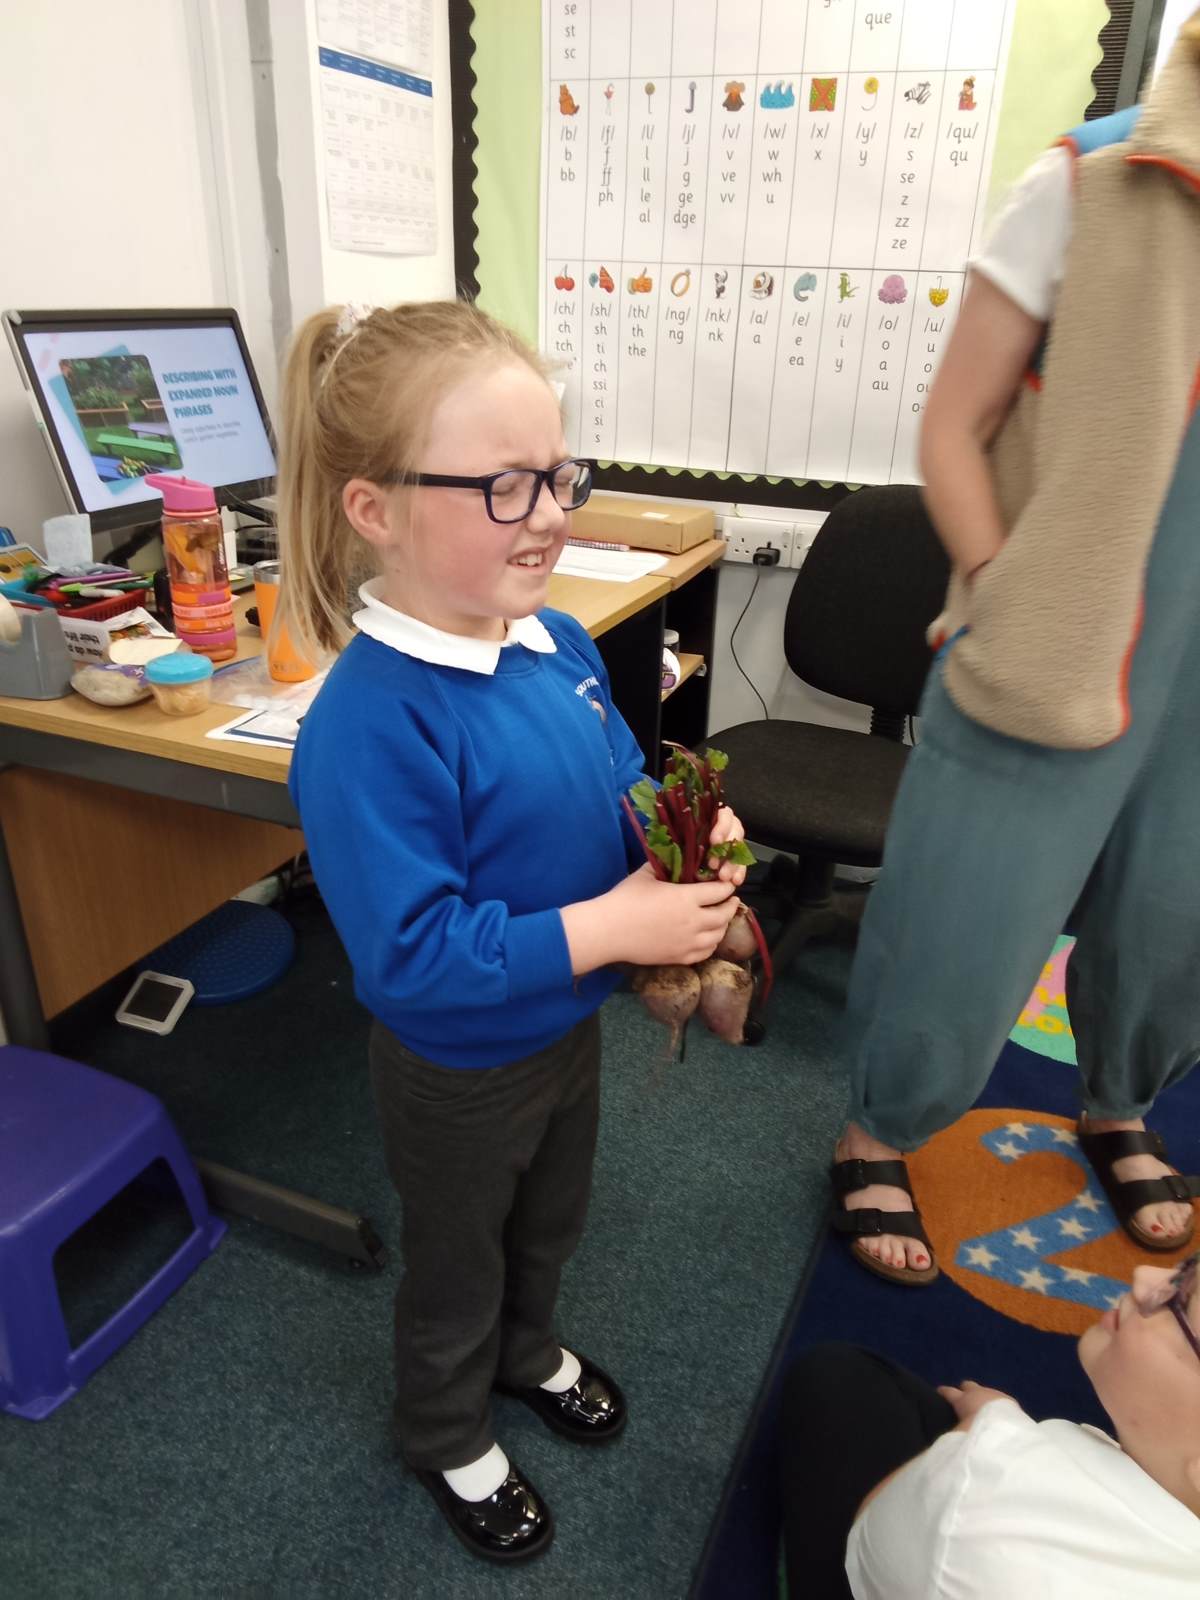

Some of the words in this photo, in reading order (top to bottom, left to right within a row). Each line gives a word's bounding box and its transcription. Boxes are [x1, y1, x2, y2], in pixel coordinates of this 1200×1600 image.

[563, 3, 577, 16] se
[864, 11, 893, 32] que
[564, 23, 576, 38] st
[563, 47, 577, 60] sc
[560, 125, 578, 142] /b/
[721, 123, 741, 141] /v/
[763, 122, 787, 140] /w/
[809, 122, 830, 140] /x/
[855, 122, 877, 145] /y/
[903, 121, 924, 140] /z/
[946, 121, 979, 145] /qu/
[564, 146, 573, 162] b
[725, 149, 735, 162] v
[767, 148, 780, 161] w
[813, 149, 822, 161] x
[858, 148, 868, 167] y
[949, 149, 969, 168] qu
[560, 167, 576, 182] bb
[600, 167, 612, 187] ff
[682, 170, 691, 188] g
[721, 171, 737, 183] ve
[761, 167, 782, 183] wh
[899, 172, 916, 184] se
[598, 187, 615, 207] ph
[678, 191, 694, 209] ge
[719, 192, 736, 204] vv
[765, 193, 775, 205] u
[900, 194, 909, 206] z
[673, 208, 697, 230] dge
[894, 216, 911, 228] zz
[891, 238, 908, 250] ze
[553, 301, 576, 316] /ch/
[590, 303, 612, 318] /sh/
[627, 304, 650, 320] /th/
[665, 306, 692, 326] /ng/
[704, 307, 732, 323] /nk/
[749, 309, 769, 326] /a/
[791, 311, 811, 328] /e/
[878, 315, 900, 331] /o/
[557, 319, 572, 334] ch
[594, 321, 608, 337] sh
[631, 323, 645, 339] th
[923, 317, 945, 334] /u/
[668, 327, 685, 345] ng
[708, 327, 724, 343] nk
[752, 334, 761, 345] a
[794, 335, 803, 347] e
[555, 338, 574, 353] tch
[596, 343, 606, 355] ti
[627, 343, 647, 358] the
[881, 340, 891, 351] o
[926, 342, 936, 353] u
[593, 358, 608, 373] ch
[788, 355, 805, 367] ea
[834, 357, 844, 374] y
[879, 360, 888, 371] a
[923, 362, 933, 374] o
[592, 379, 608, 392] ssi
[871, 379, 890, 392] au
[594, 398, 605, 410] ci
[594, 414, 604, 427] si
